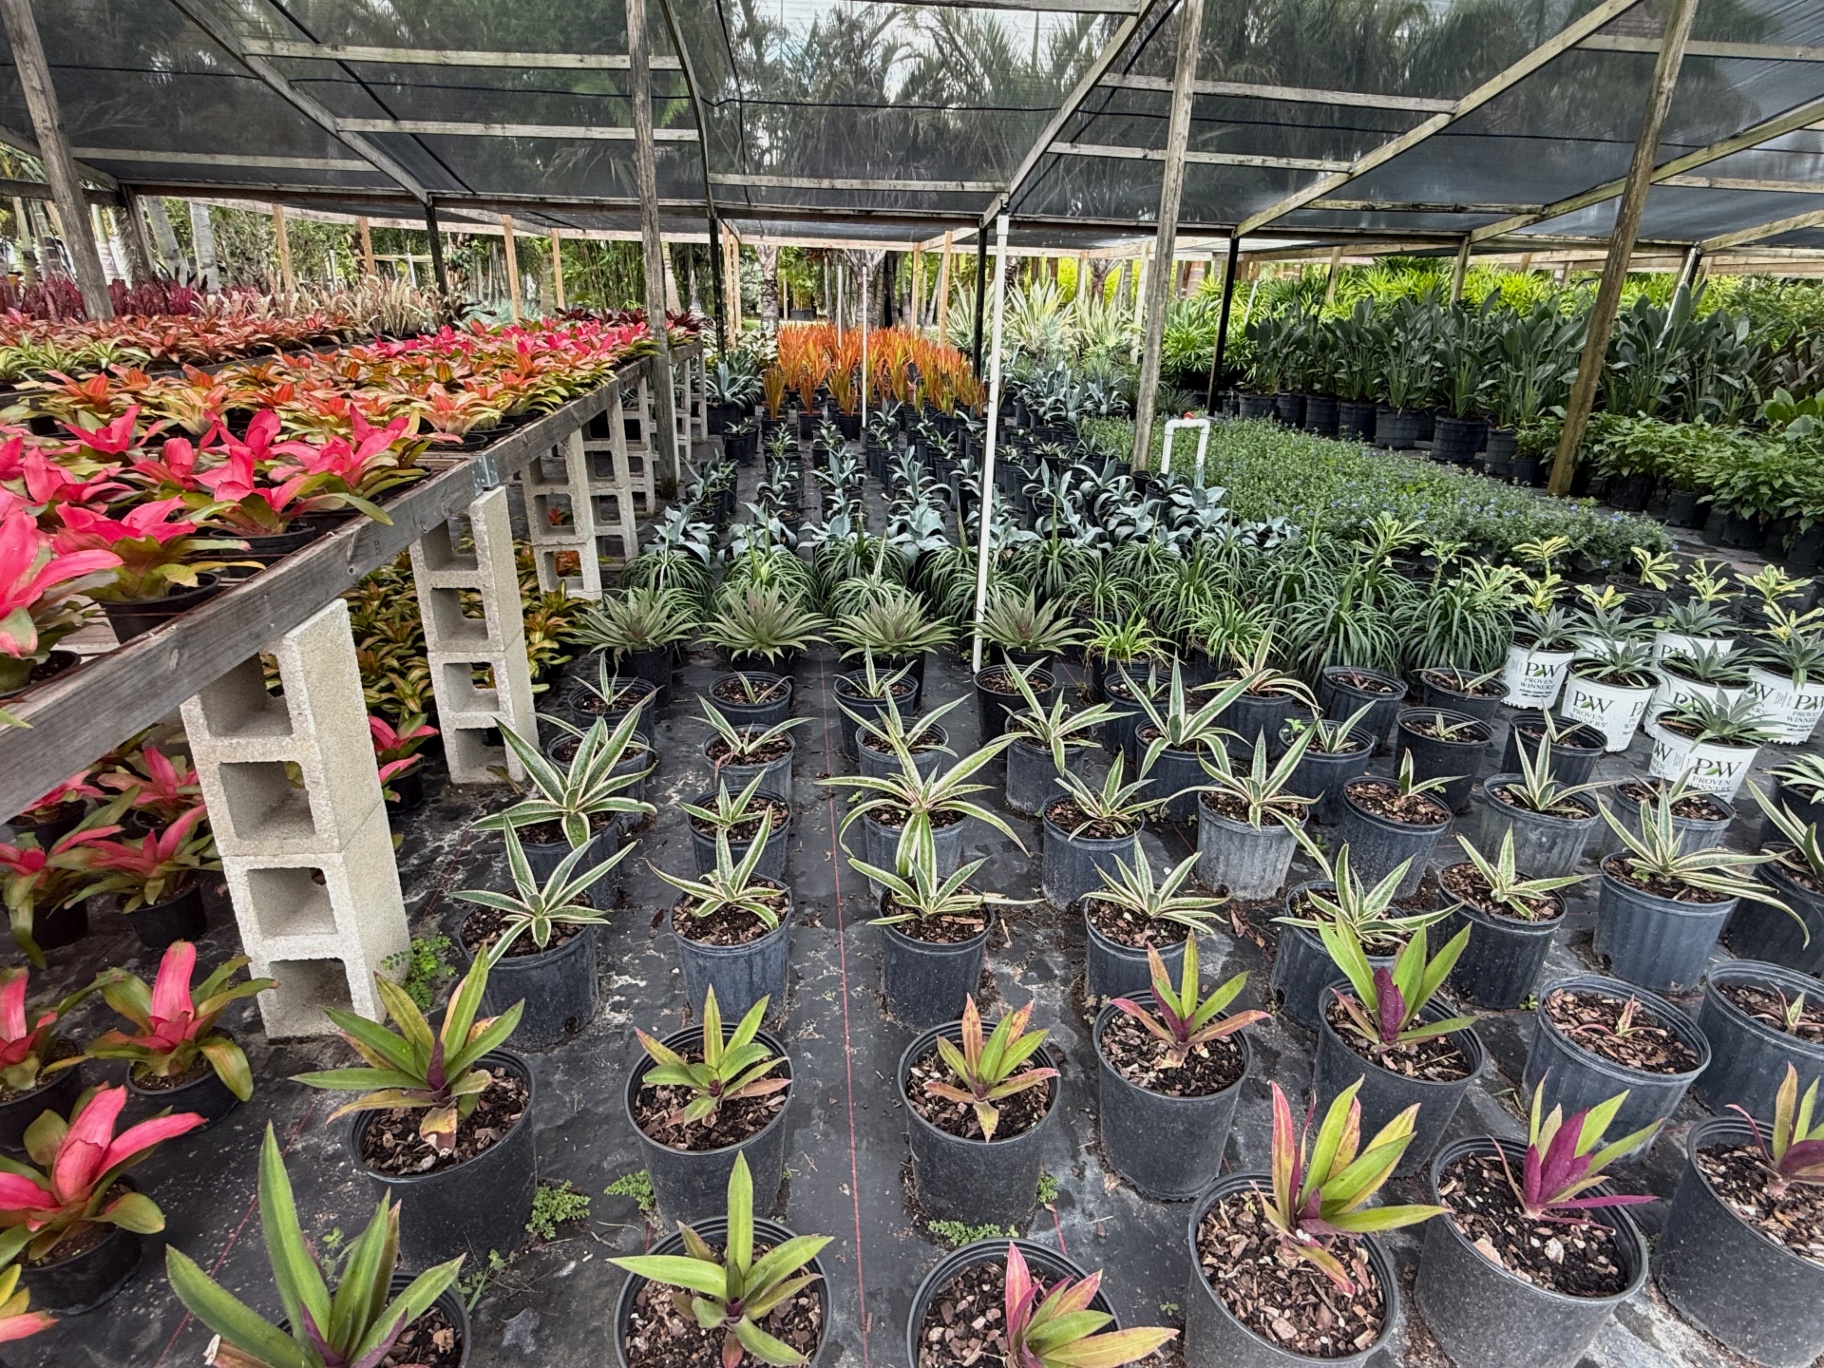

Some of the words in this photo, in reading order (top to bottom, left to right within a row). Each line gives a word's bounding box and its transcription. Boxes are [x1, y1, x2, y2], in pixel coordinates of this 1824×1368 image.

[1524, 661, 1560, 678] PW
[1573, 690, 1615, 714] PW
[1572, 707, 1605, 721] PROVEN
[1693, 757, 1743, 778] PW
[1692, 776, 1732, 786] PROVEN
